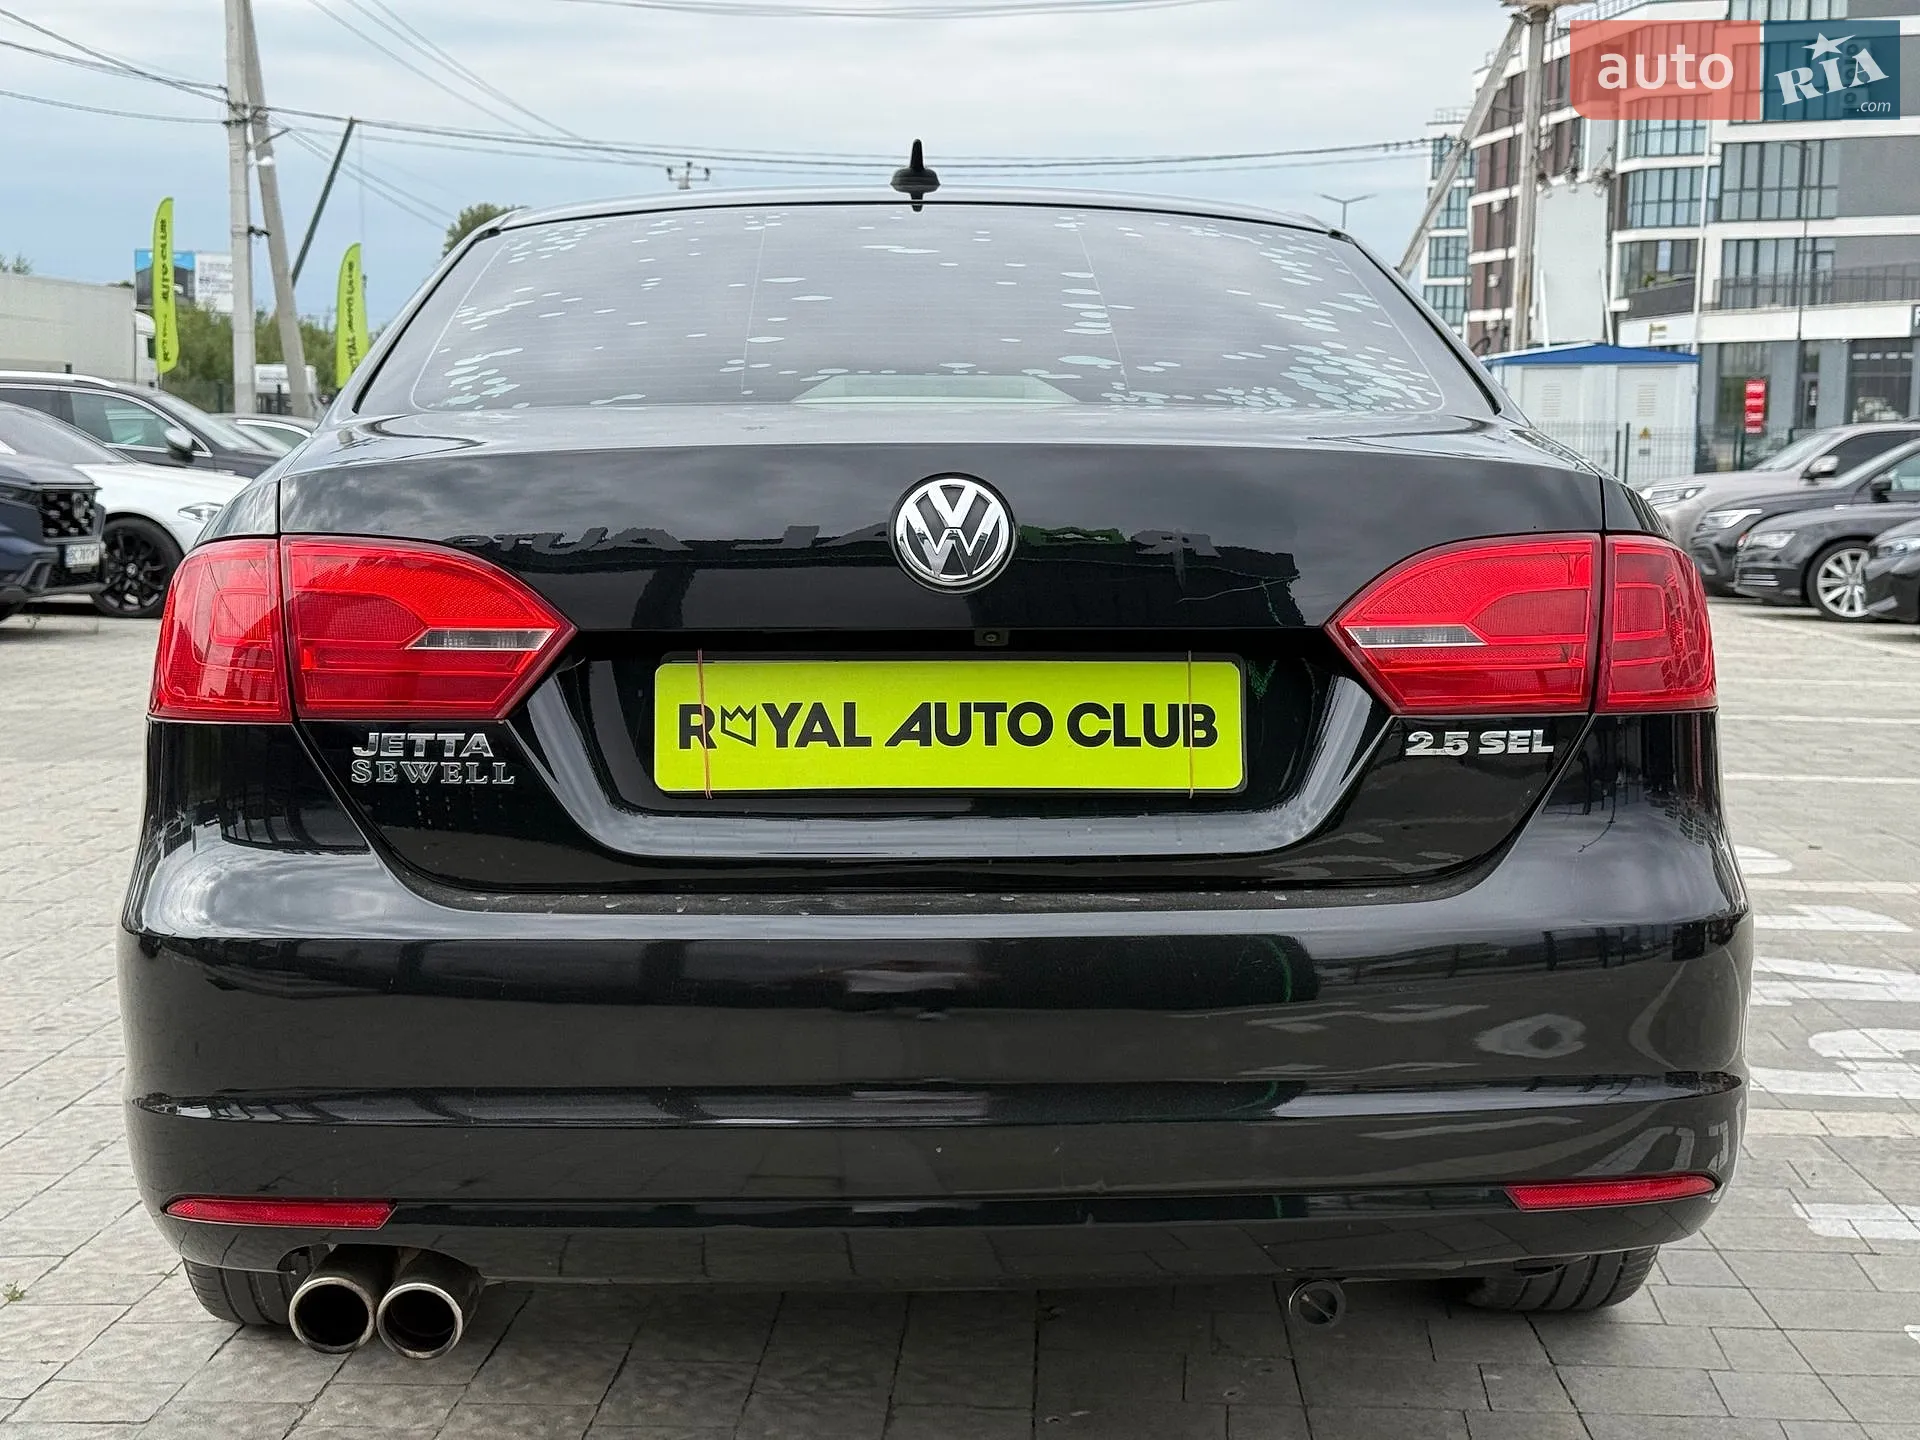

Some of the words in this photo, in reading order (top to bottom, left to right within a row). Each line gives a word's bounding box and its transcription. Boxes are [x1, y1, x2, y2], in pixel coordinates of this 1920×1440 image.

[885, 701, 1054, 749] AUTO
[1066, 701, 1218, 749] CLUB
[352, 732, 494, 758] JETTA
[1478, 729, 1555, 755] SEL
[351, 759, 515, 785] SEWELL
